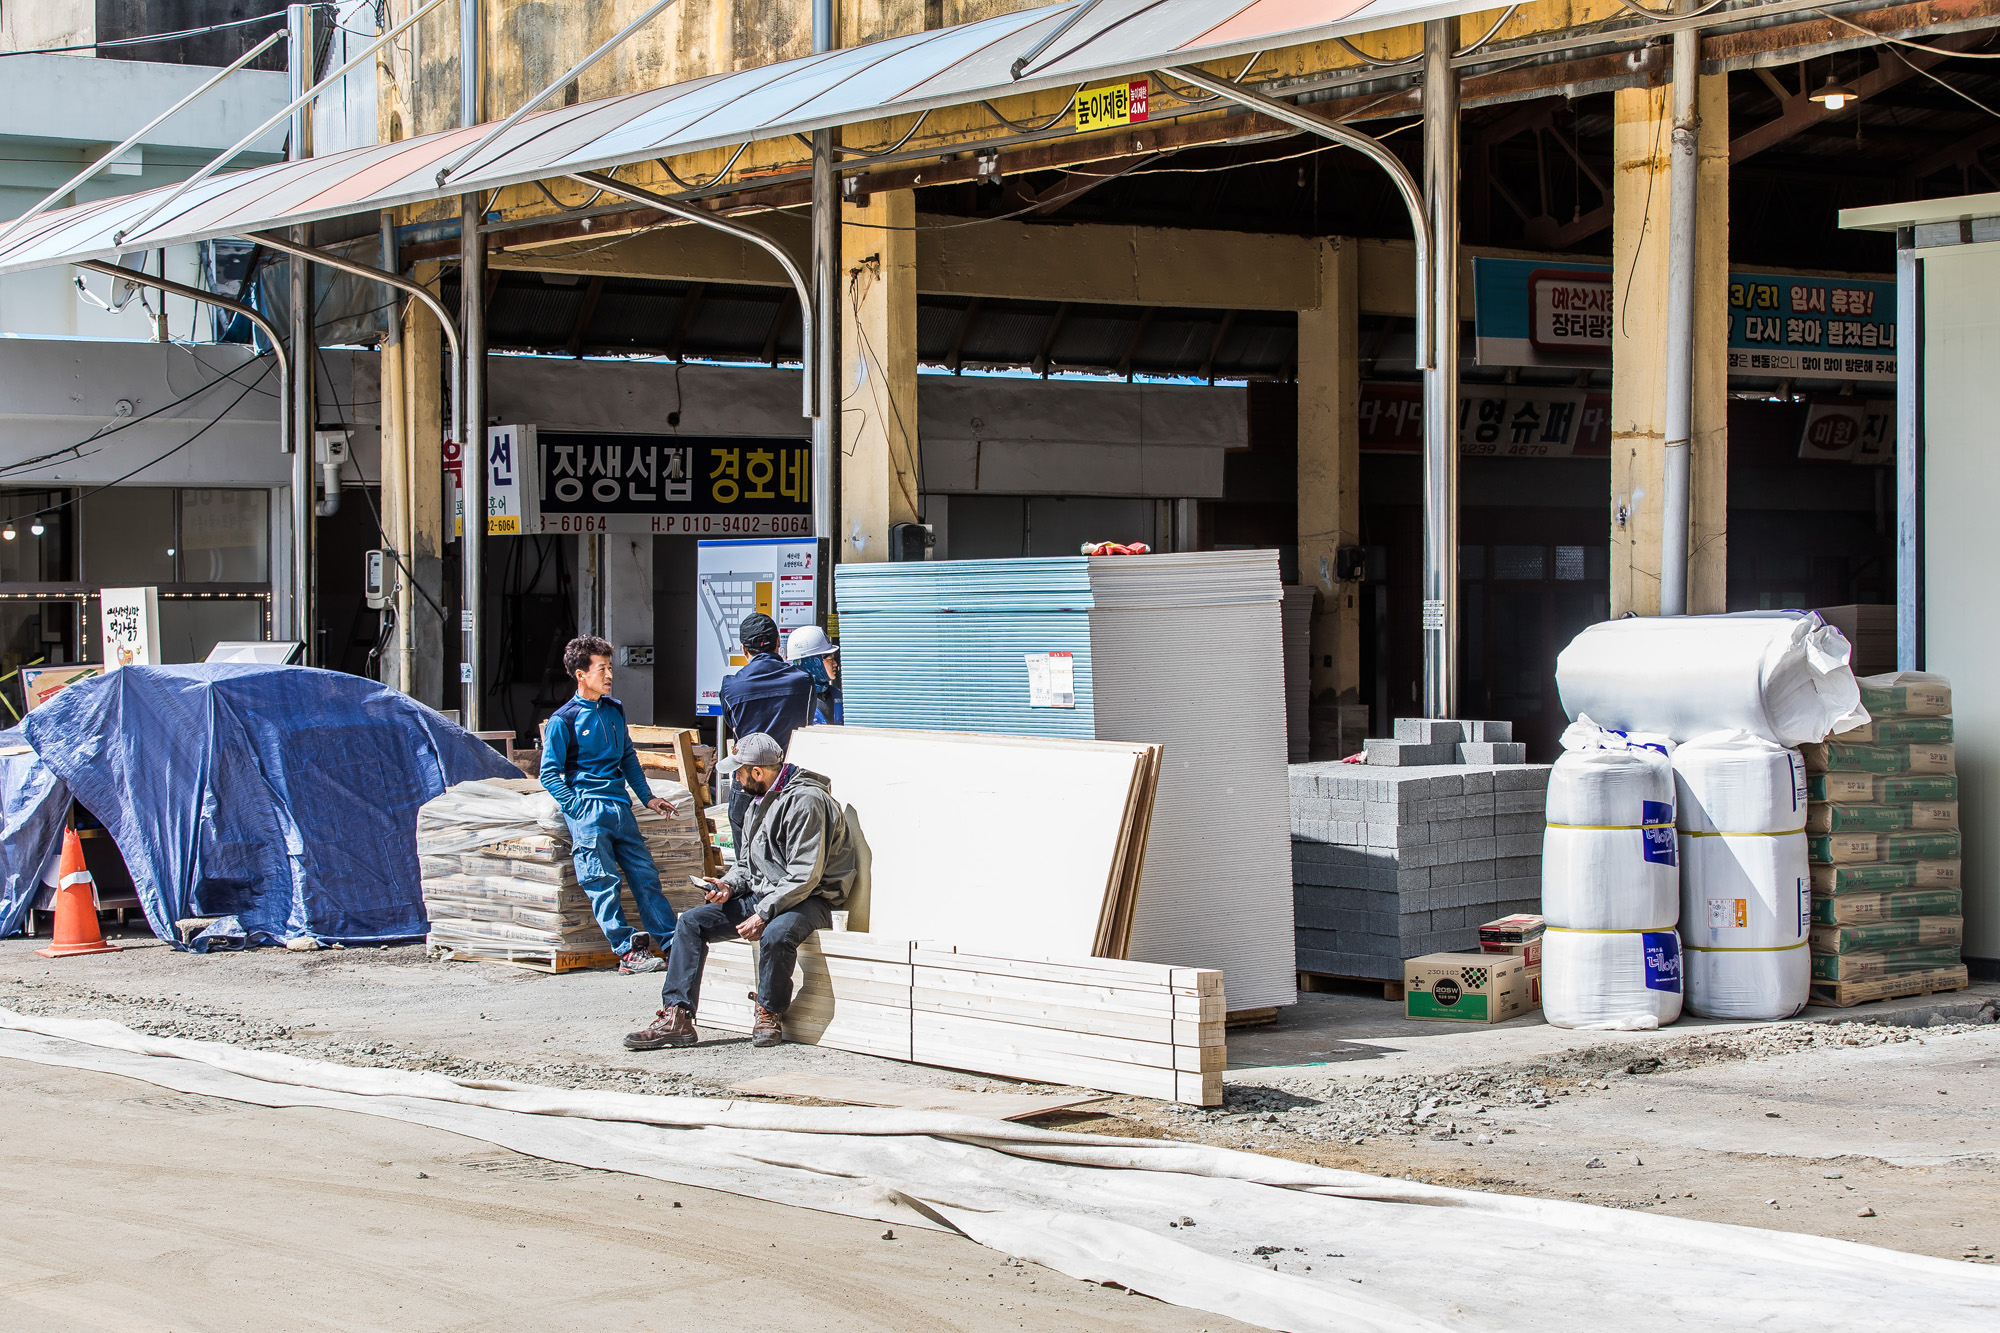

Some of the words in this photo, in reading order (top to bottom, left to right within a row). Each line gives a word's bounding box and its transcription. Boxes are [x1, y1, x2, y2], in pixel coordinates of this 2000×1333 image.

[1130, 85, 1147, 101] 높이제한
[1078, 88, 1128, 125] 높이제한
[1130, 101, 1146, 114] 4M
[1730, 283, 1779, 309] 3/31
[1790, 285, 1826, 313] 임시
[1830, 288, 1875, 316] 휴장!
[1745, 316, 1781, 342] 다시
[1787, 317, 1822, 344] 찾아
[1751, 354, 1799, 369] 변동없으니
[1802, 357, 1821, 371] 많이
[1824, 358, 1842, 372] 많이
[1845, 359, 1873, 374] 방문해
[1359, 400, 1423, 437] 다시다
[1584, 408, 1611, 443] 다
[1814, 420, 1853, 445] 미원
[1862, 414, 1897, 454] 진
[1508, 445, 1548, 456] 4679
[709, 447, 809, 504] 경호네
[488, 496, 506, 515] 홍어
[651, 516, 675, 532] H.P
[682, 517, 809, 532] 010-9402-6064
[562, 953, 580, 966] KPP
[1436, 986, 1459, 994] 205W
